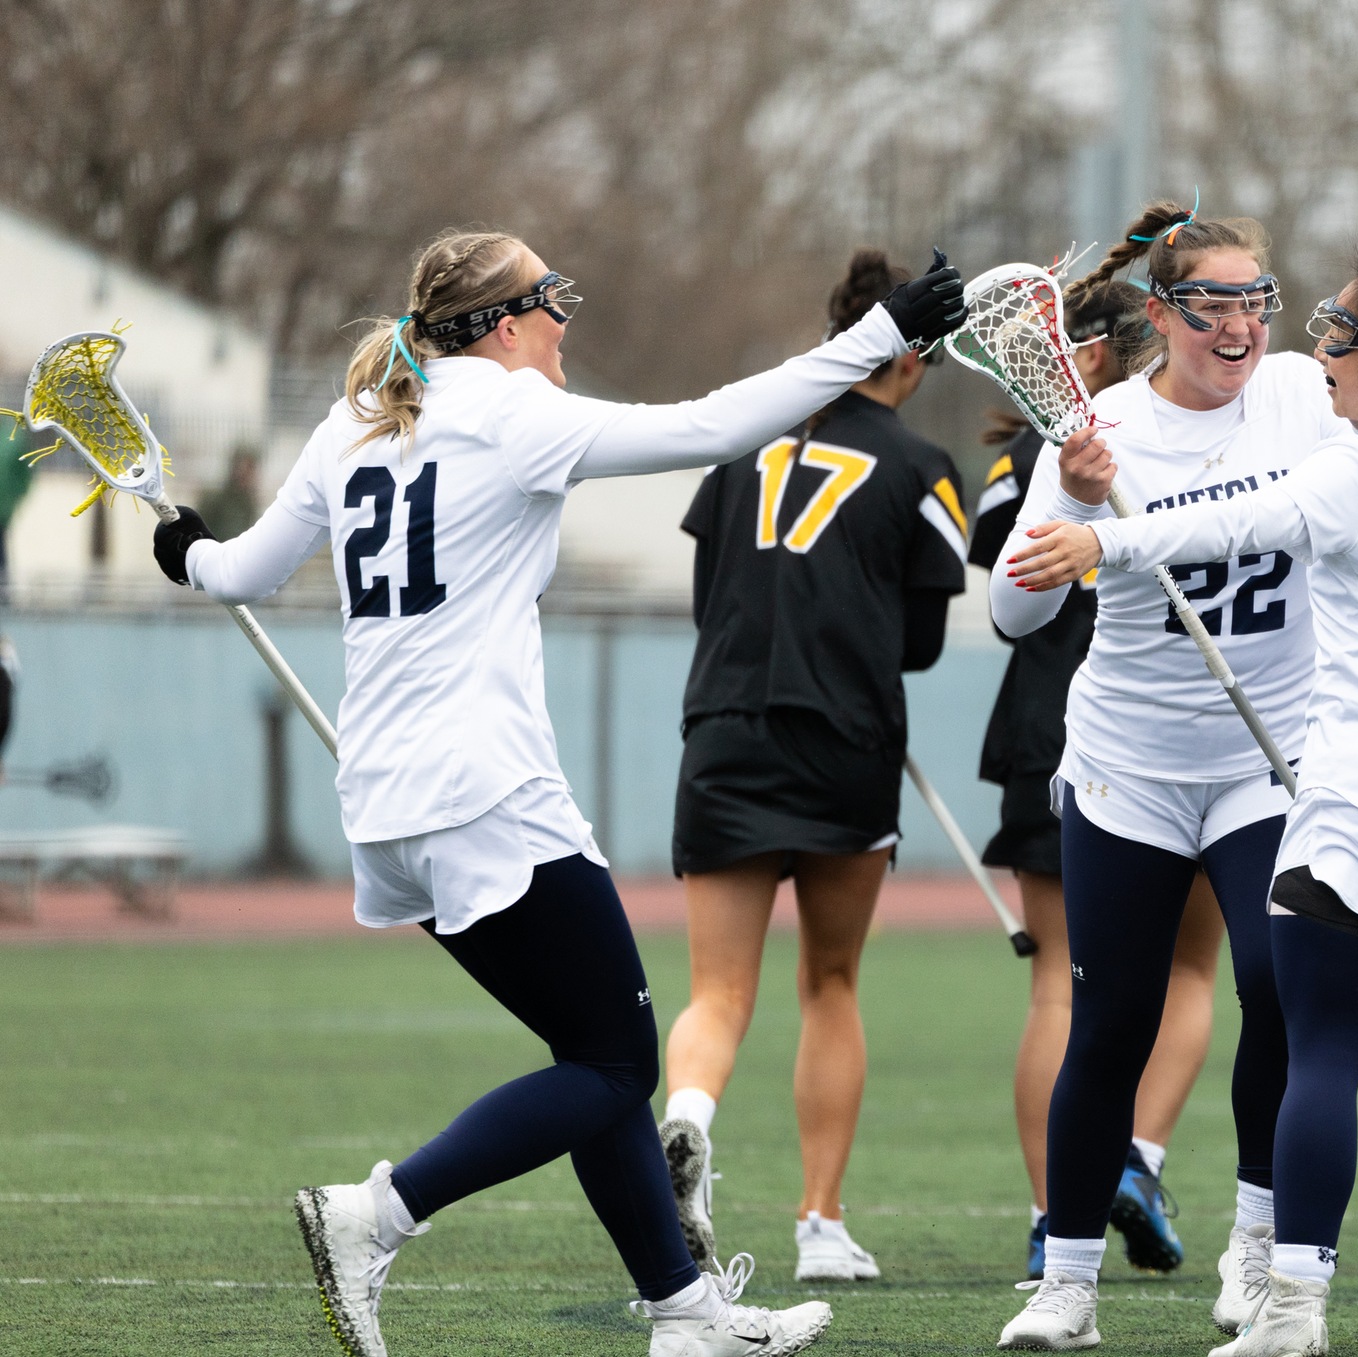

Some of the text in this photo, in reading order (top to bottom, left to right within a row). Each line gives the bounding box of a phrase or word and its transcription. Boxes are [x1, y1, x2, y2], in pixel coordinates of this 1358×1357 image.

[429, 320, 459, 336] STX
[470, 302, 510, 325] STX
[521, 293, 545, 310] ST
[344, 461, 447, 618] 21
[757, 435, 878, 554] 17
[1165, 549, 1294, 636] 22
